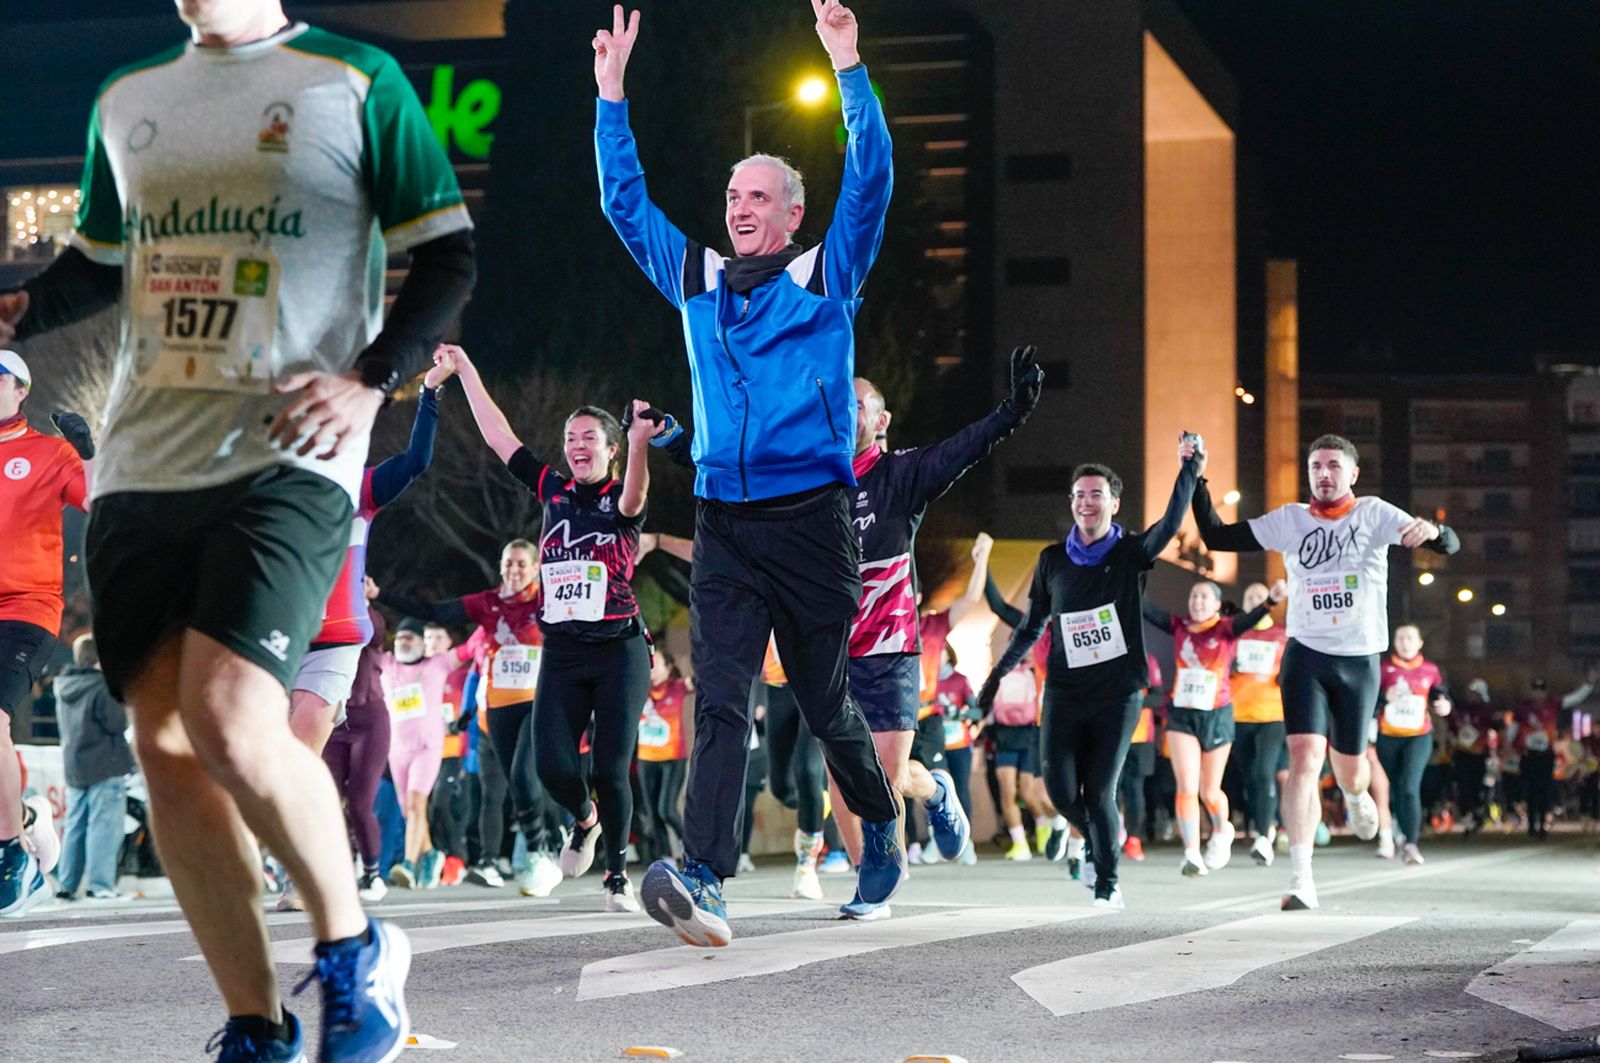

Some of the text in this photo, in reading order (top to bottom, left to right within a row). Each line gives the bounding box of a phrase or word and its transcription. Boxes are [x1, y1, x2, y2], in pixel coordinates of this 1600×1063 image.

[162, 297, 239, 340] 1577
[554, 582, 592, 601] 4341
[1312, 591, 1354, 610] 6058
[1072, 626, 1112, 649] 6536
[502, 660, 531, 674] 5150
